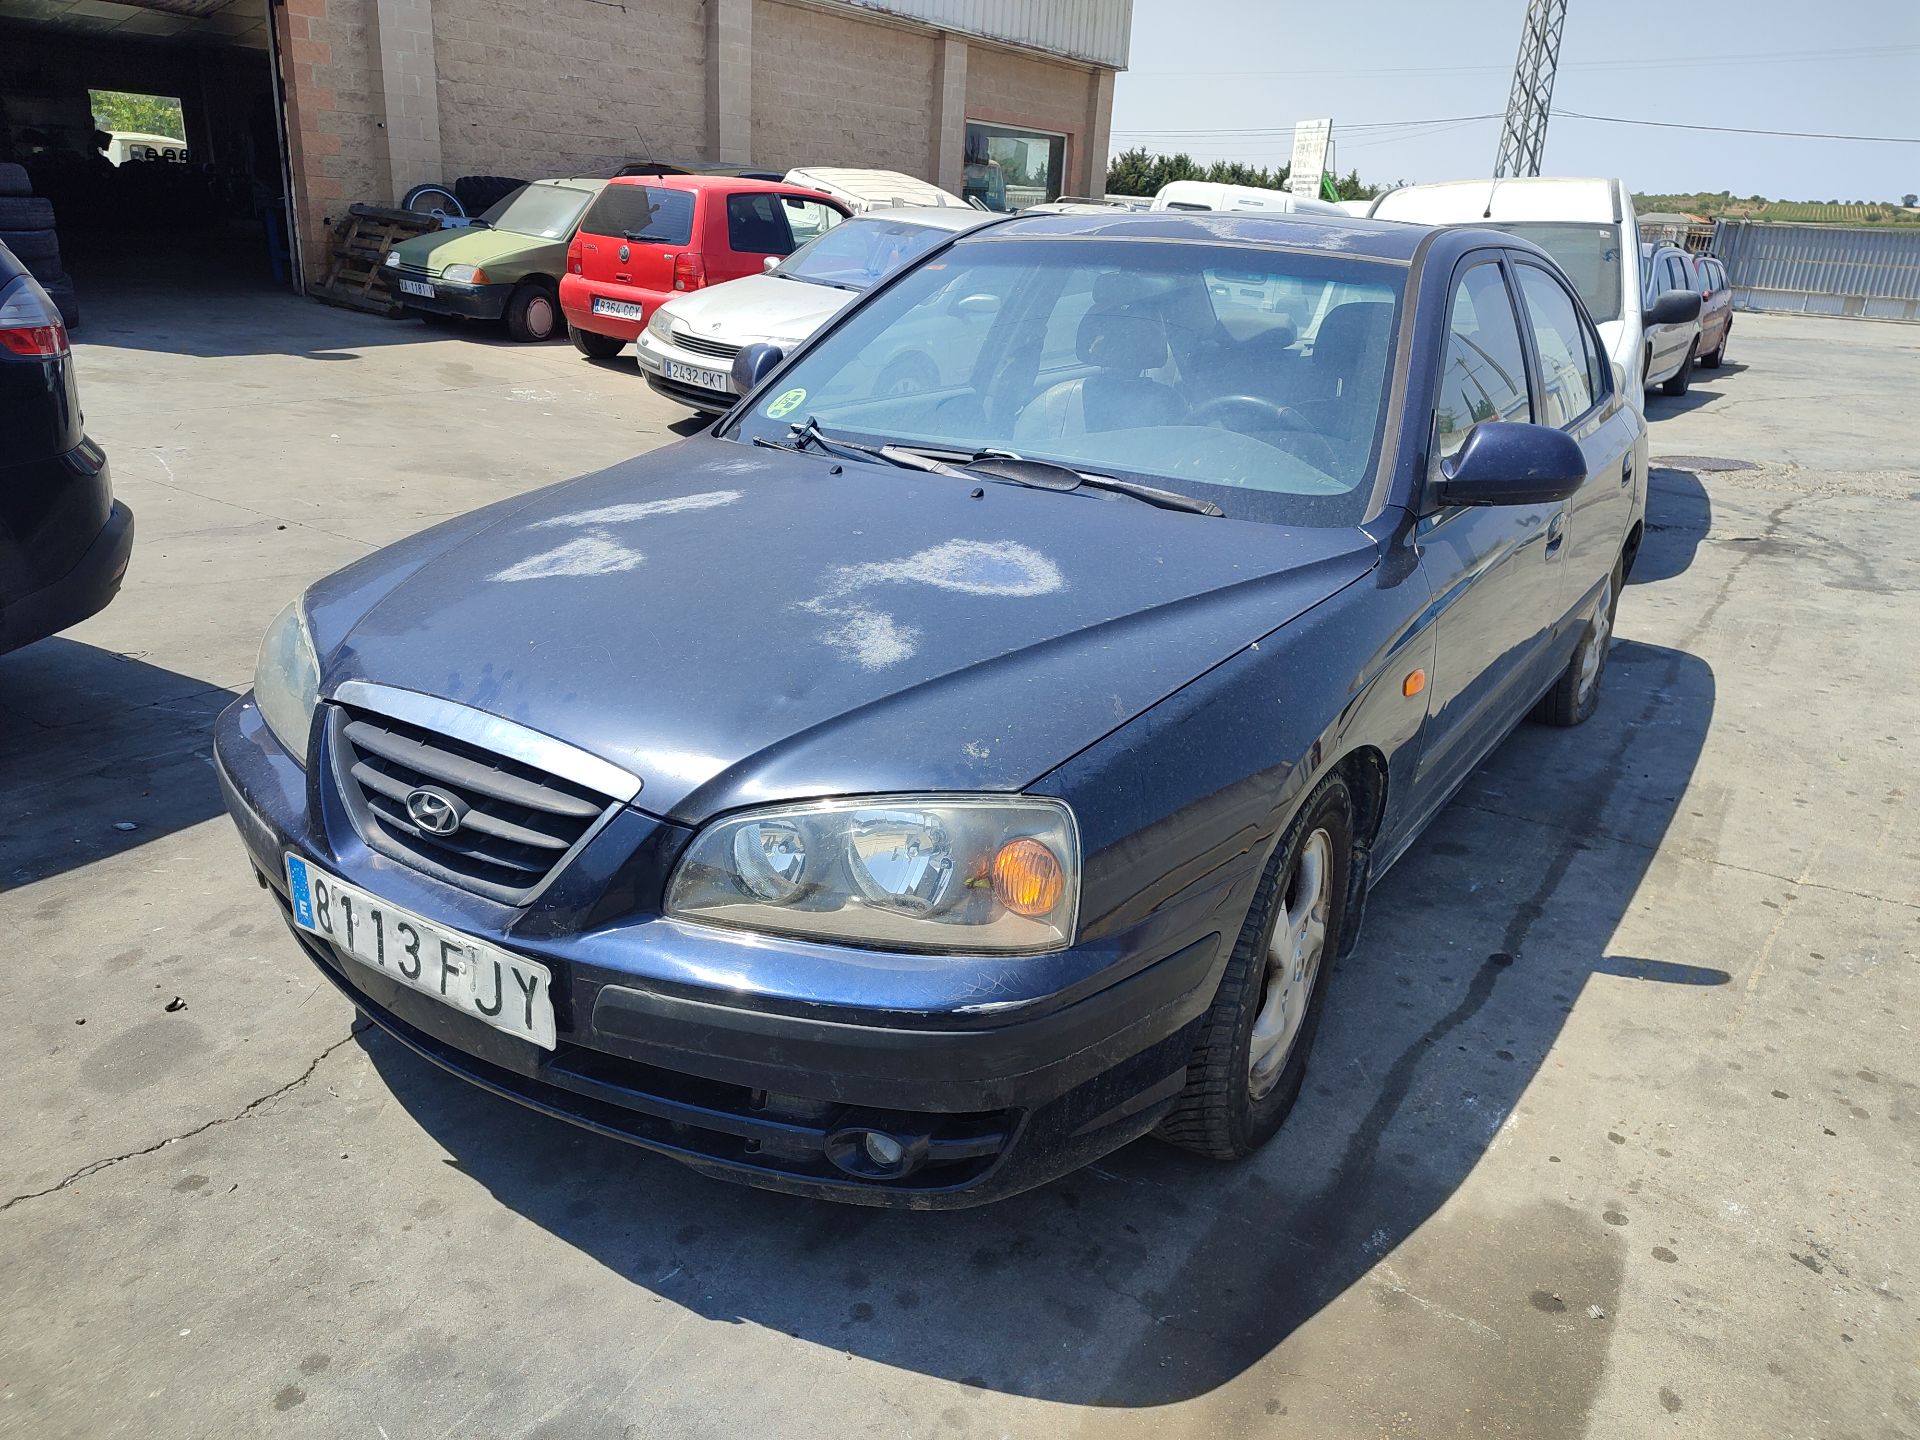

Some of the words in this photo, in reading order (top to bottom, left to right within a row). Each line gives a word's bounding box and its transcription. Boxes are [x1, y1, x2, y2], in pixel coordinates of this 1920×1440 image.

[600, 301, 621, 314] 8364
[673, 364, 699, 384] 2432
[702, 371, 723, 389] CKT
[299, 900, 308, 918] E
[315, 879, 420, 980] 8113
[440, 939, 538, 1030] FJY
